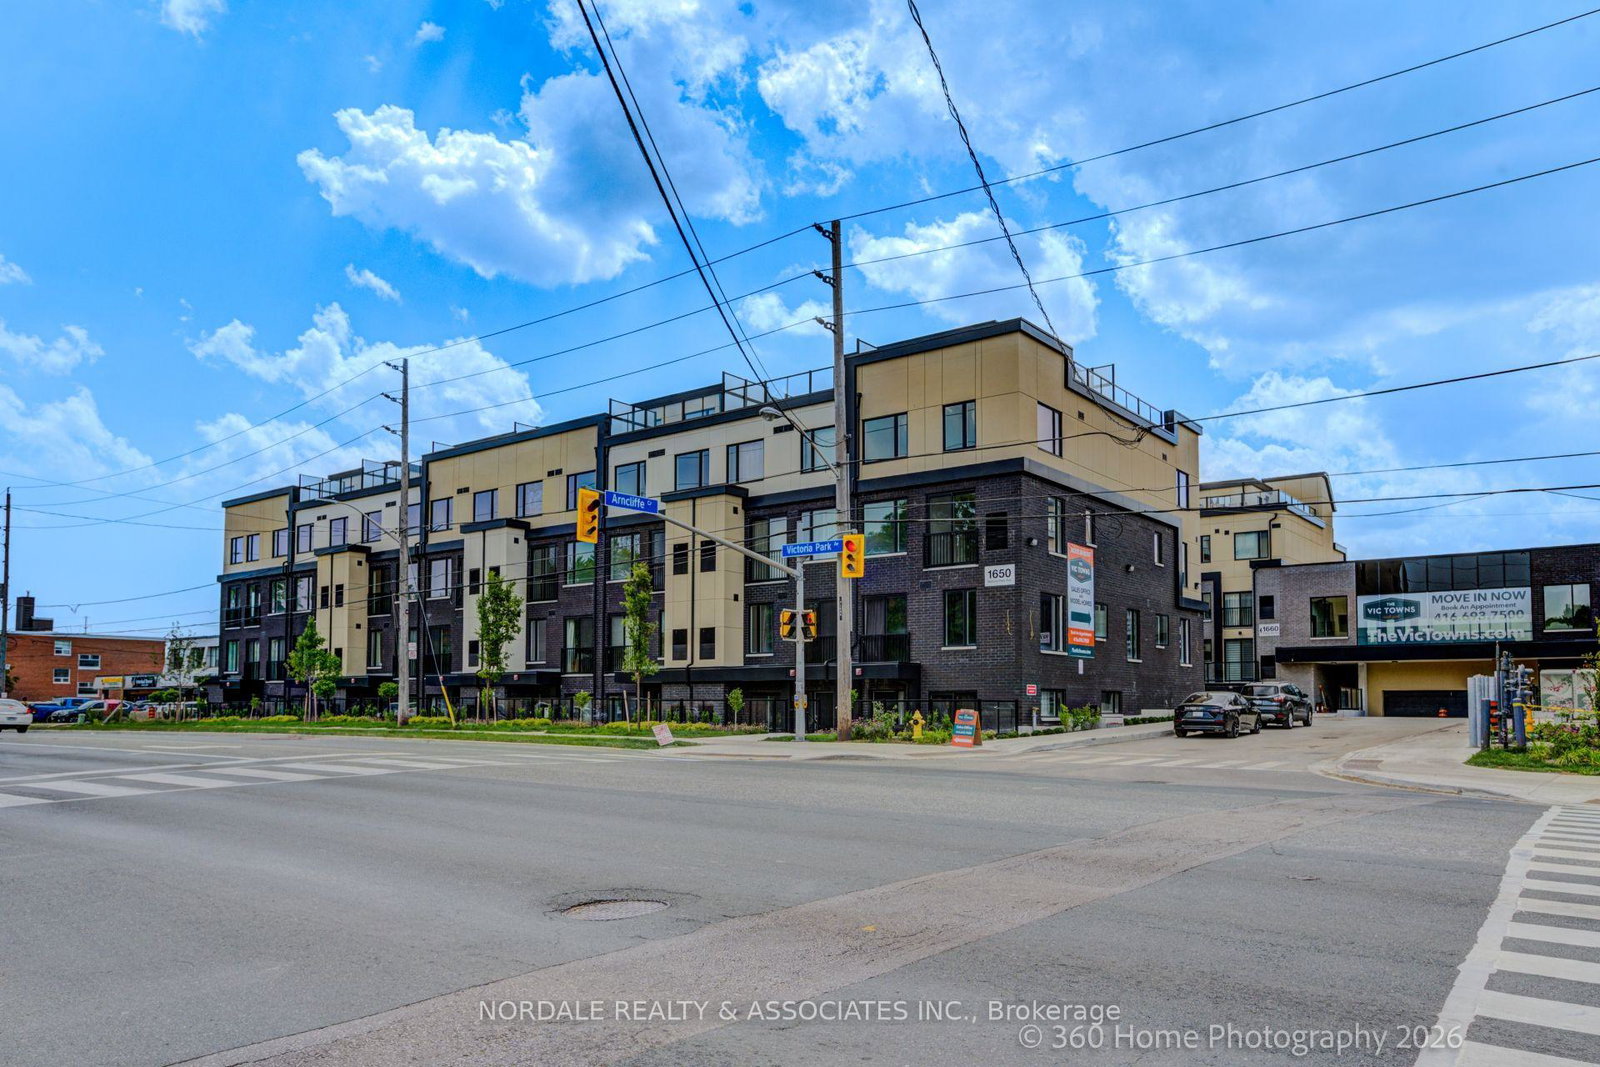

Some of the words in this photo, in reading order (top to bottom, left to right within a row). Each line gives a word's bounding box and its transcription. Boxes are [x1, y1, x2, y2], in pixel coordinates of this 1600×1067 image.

[611, 494, 645, 509] Arncliffe
[786, 544, 813, 554] Victoria
[815, 542, 832, 552] Park
[988, 568, 1012, 579] 1650
[1431, 593, 1470, 604] MOVE
[1473, 592, 1487, 602] IN
[1491, 590, 1526, 601] NOW
[1470, 602, 1516, 611] Appointment
